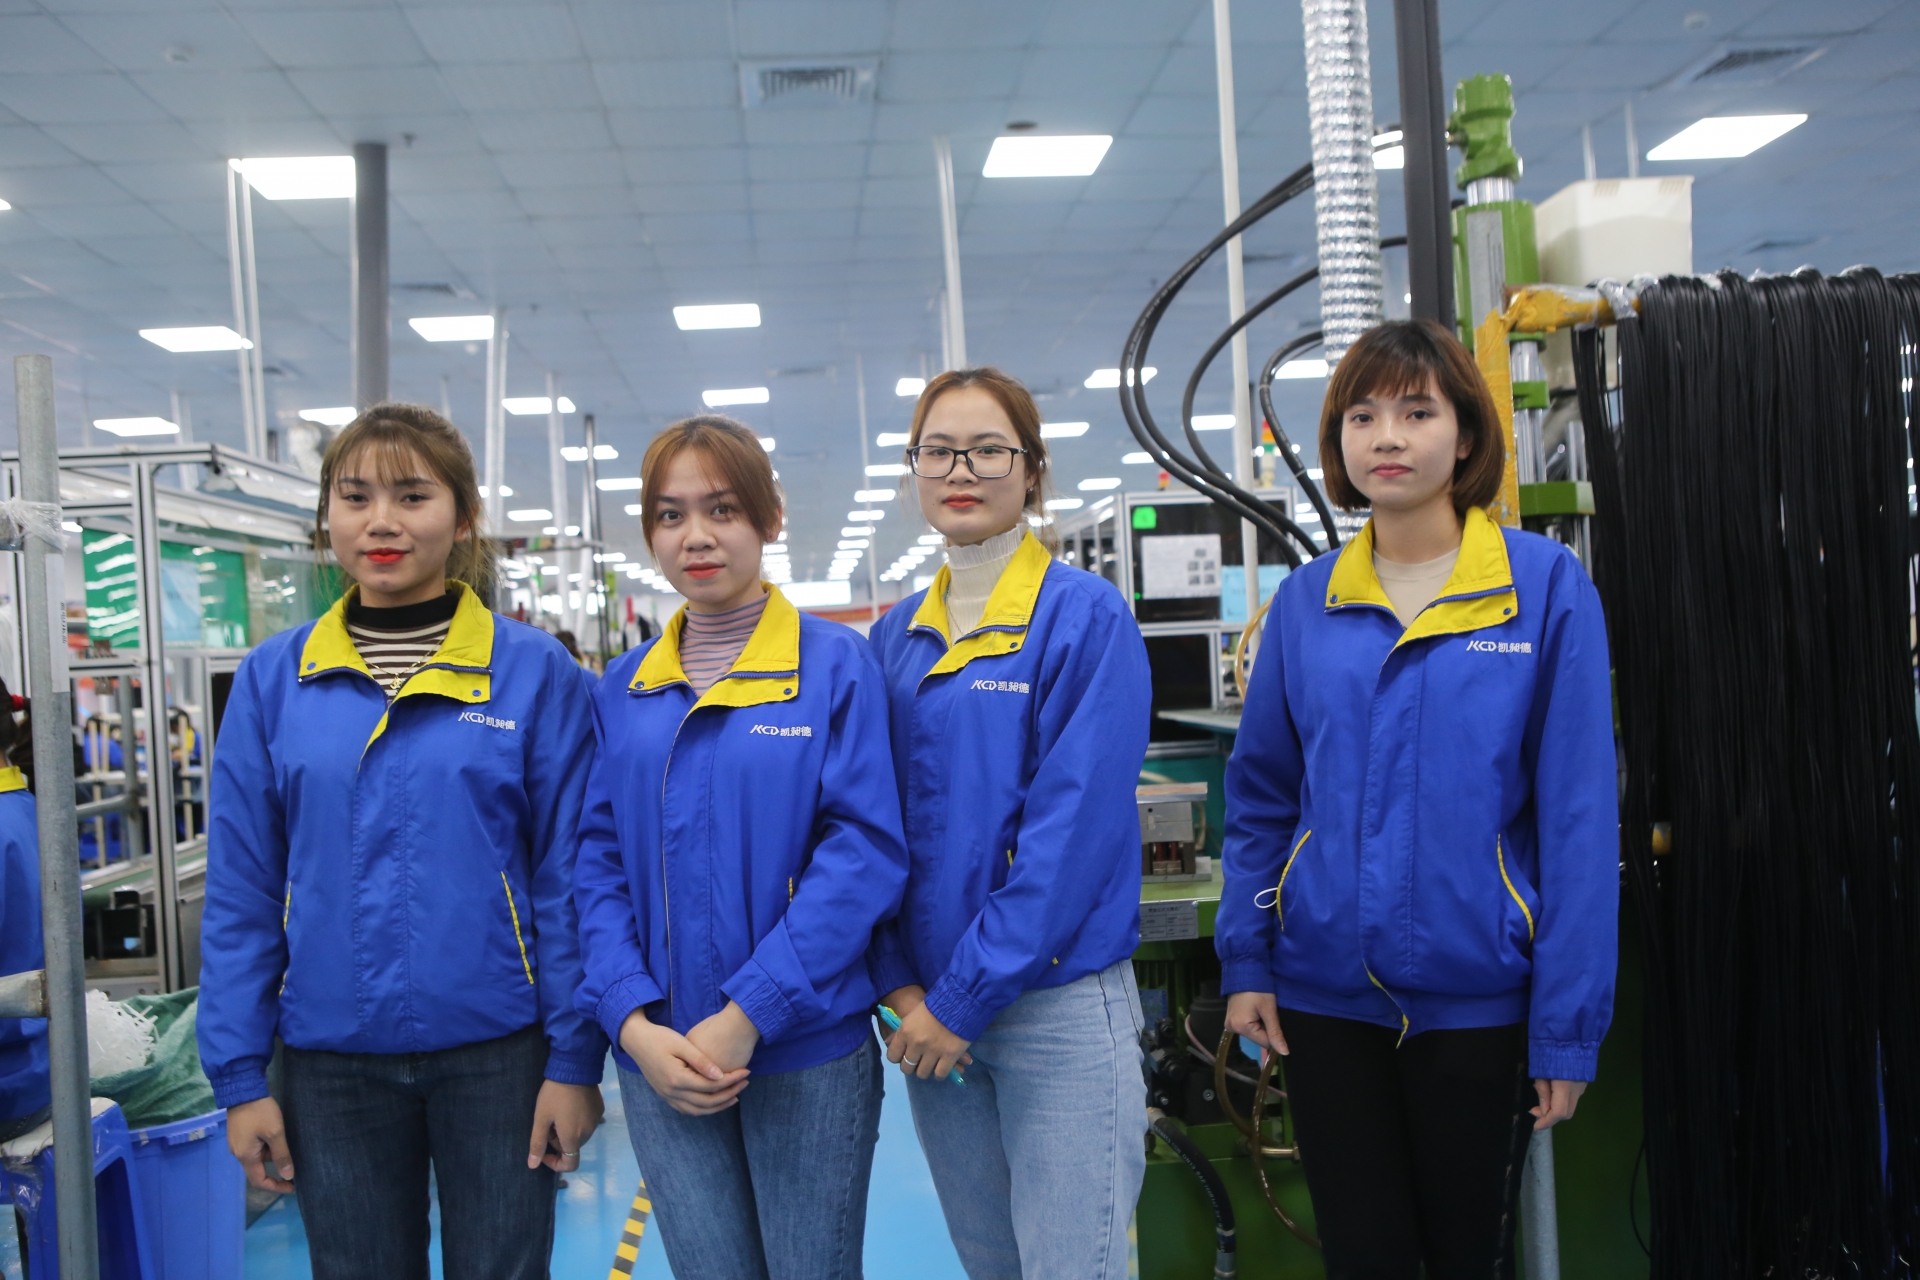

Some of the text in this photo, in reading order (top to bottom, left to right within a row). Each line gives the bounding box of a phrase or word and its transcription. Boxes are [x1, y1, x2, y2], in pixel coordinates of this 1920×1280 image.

[1466, 640, 1497, 652] KCD
[970, 680, 997, 691] KCD
[458, 712, 485, 724] KCD
[750, 724, 779, 736] KCD
[1196, 1171, 1206, 1183] SAE
